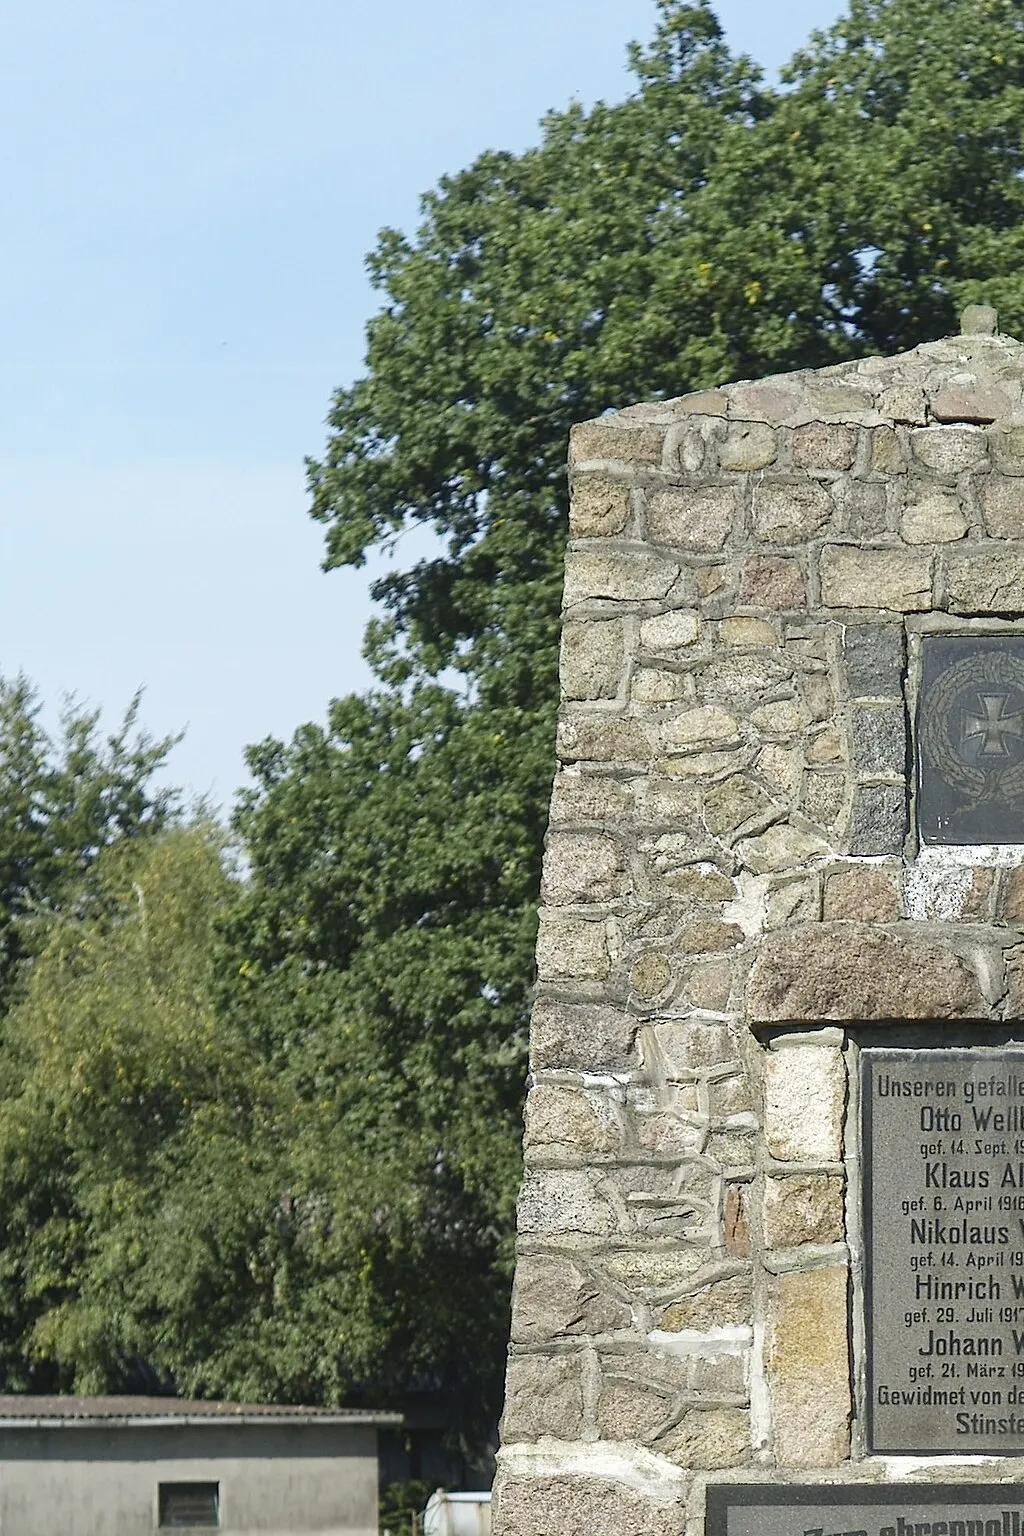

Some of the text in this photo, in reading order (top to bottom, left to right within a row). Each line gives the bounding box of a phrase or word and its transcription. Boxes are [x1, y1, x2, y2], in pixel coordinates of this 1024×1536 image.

[878, 1075, 955, 1097] Unseren
[920, 1106, 961, 1131] Otto
[921, 1141, 945, 1159] gef.
[951, 1140, 968, 1154] 14.
[975, 1140, 1009, 1159] Sept.
[925, 1163, 989, 1188] Klaus
[902, 1197, 926, 1215] gef.
[934, 1197, 947, 1211] 6.
[954, 1196, 992, 1214] April
[910, 1219, 1008, 1244] Nikolaus
[910, 1252, 935, 1271] gef.
[941, 1252, 959, 1266] 14.
[966, 1252, 1004, 1270] April
[916, 1275, 1000, 1300] Hinrich
[904, 1308, 930, 1327] gef.
[936, 1308, 959, 1322] 29.
[966, 1308, 992, 1322] Juli
[919, 1330, 1002, 1356] Johann
[909, 1364, 934, 1382] gef.
[941, 1364, 959, 1378] 21.
[967, 1364, 1004, 1378] März
[878, 1386, 965, 1405] Gewidmet
[970, 1390, 1000, 1404] von
